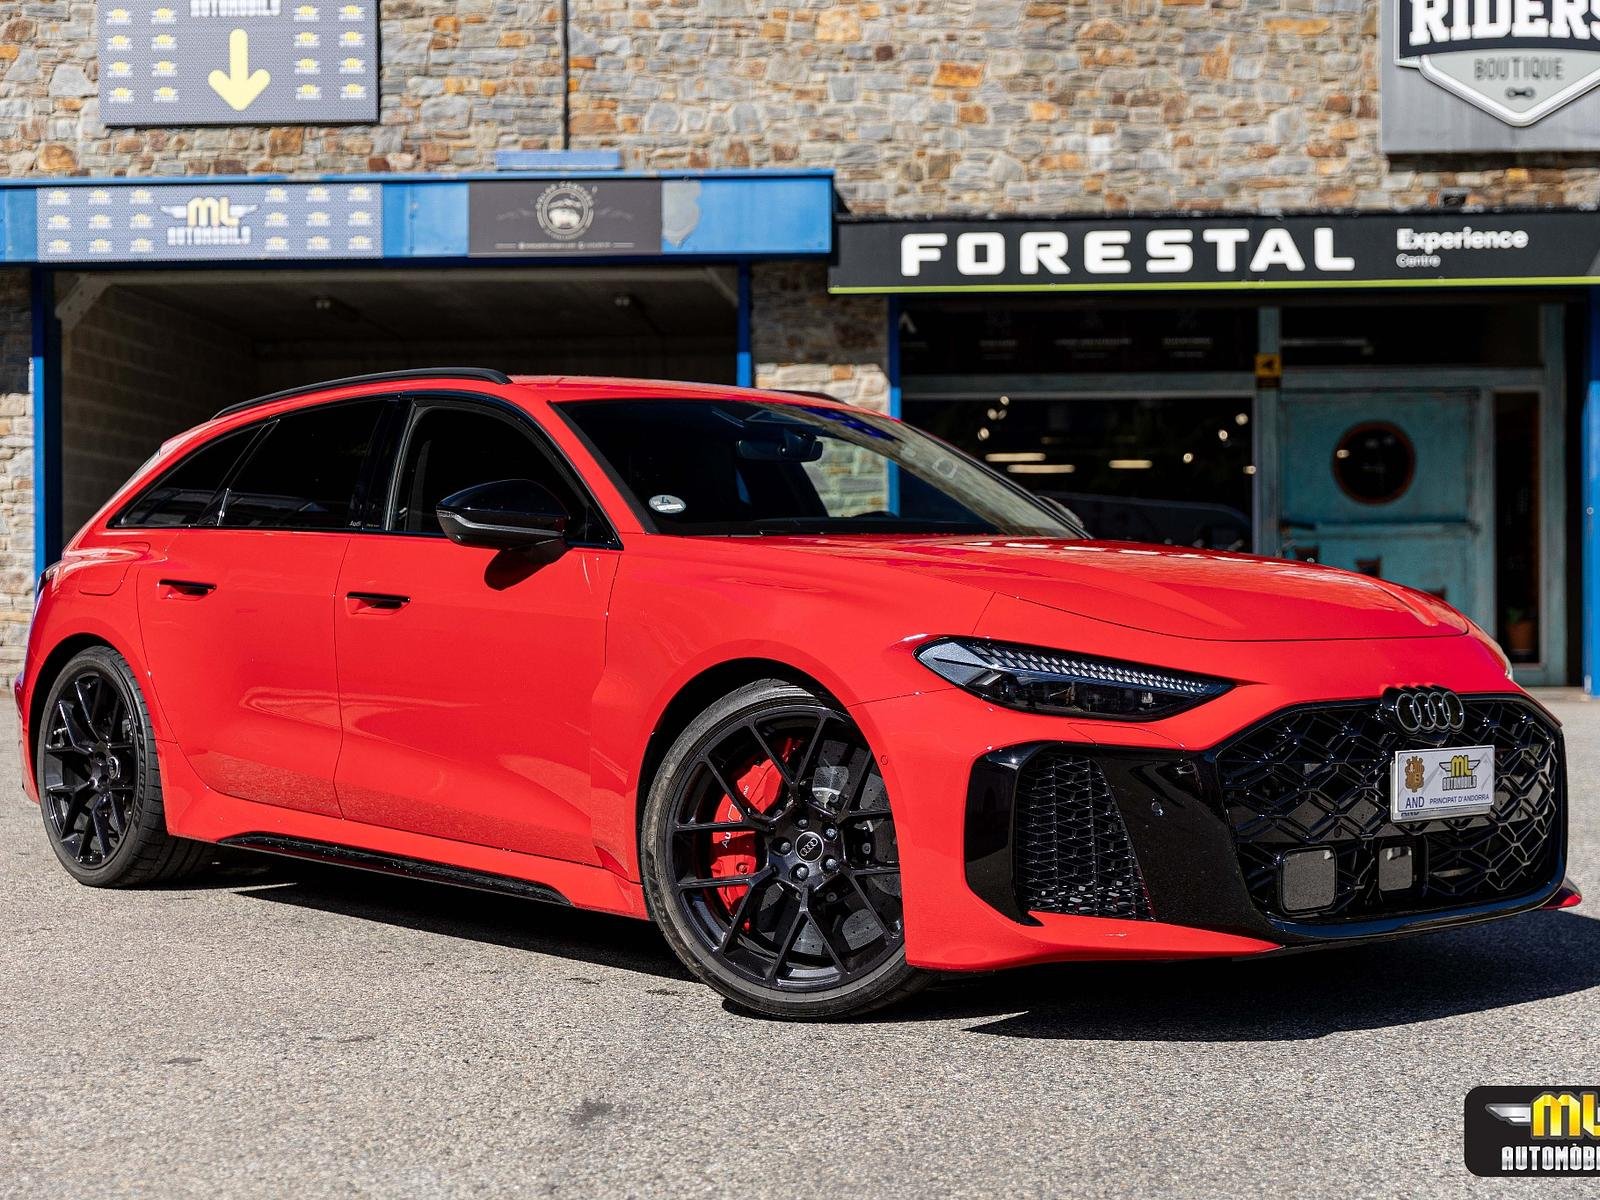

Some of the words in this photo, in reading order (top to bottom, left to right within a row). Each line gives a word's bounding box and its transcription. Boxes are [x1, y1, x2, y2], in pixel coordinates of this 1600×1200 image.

[1409, 0, 1600, 46] RIDER
[1474, 57, 1565, 80] BOUTIQUE
[187, 196, 240, 227] ML
[900, 227, 1356, 277] FORESTAL
[1396, 226, 1530, 255] Experience
[1396, 253, 1441, 268] Centre
[1450, 755, 1473, 777] ML
[1405, 796, 1425, 809] AND
[1429, 796, 1458, 805] PRINCIPAT
[1458, 793, 1489, 803] D'ANDORRA
